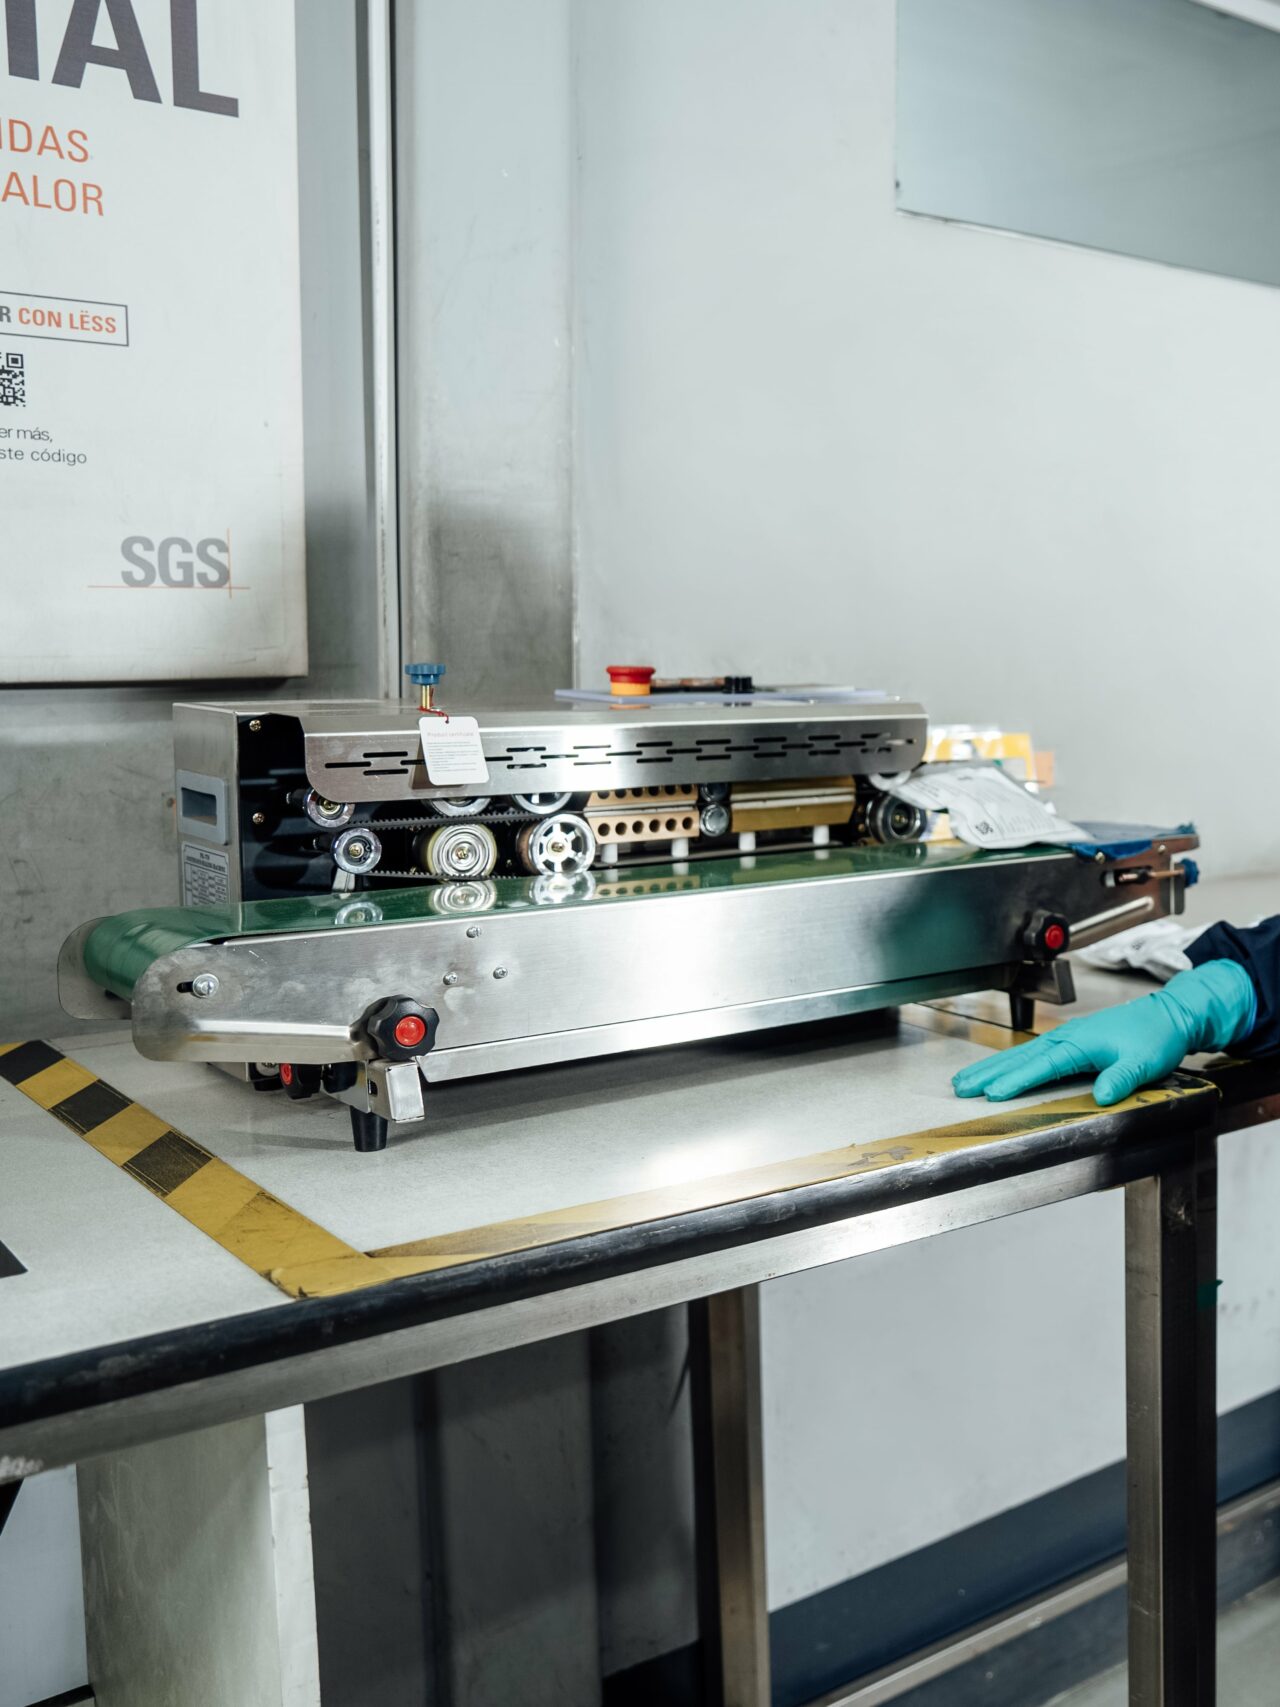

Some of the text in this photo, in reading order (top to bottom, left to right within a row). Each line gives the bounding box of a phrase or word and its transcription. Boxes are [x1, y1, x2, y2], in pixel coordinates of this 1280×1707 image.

[2, 171, 104, 216] ALOR
[18, 307, 62, 328] CON
[69, 310, 117, 334] LËSS
[0, 427, 53, 443] er más,
[0, 447, 87, 466] ste código
[120, 535, 230, 588] SGS
